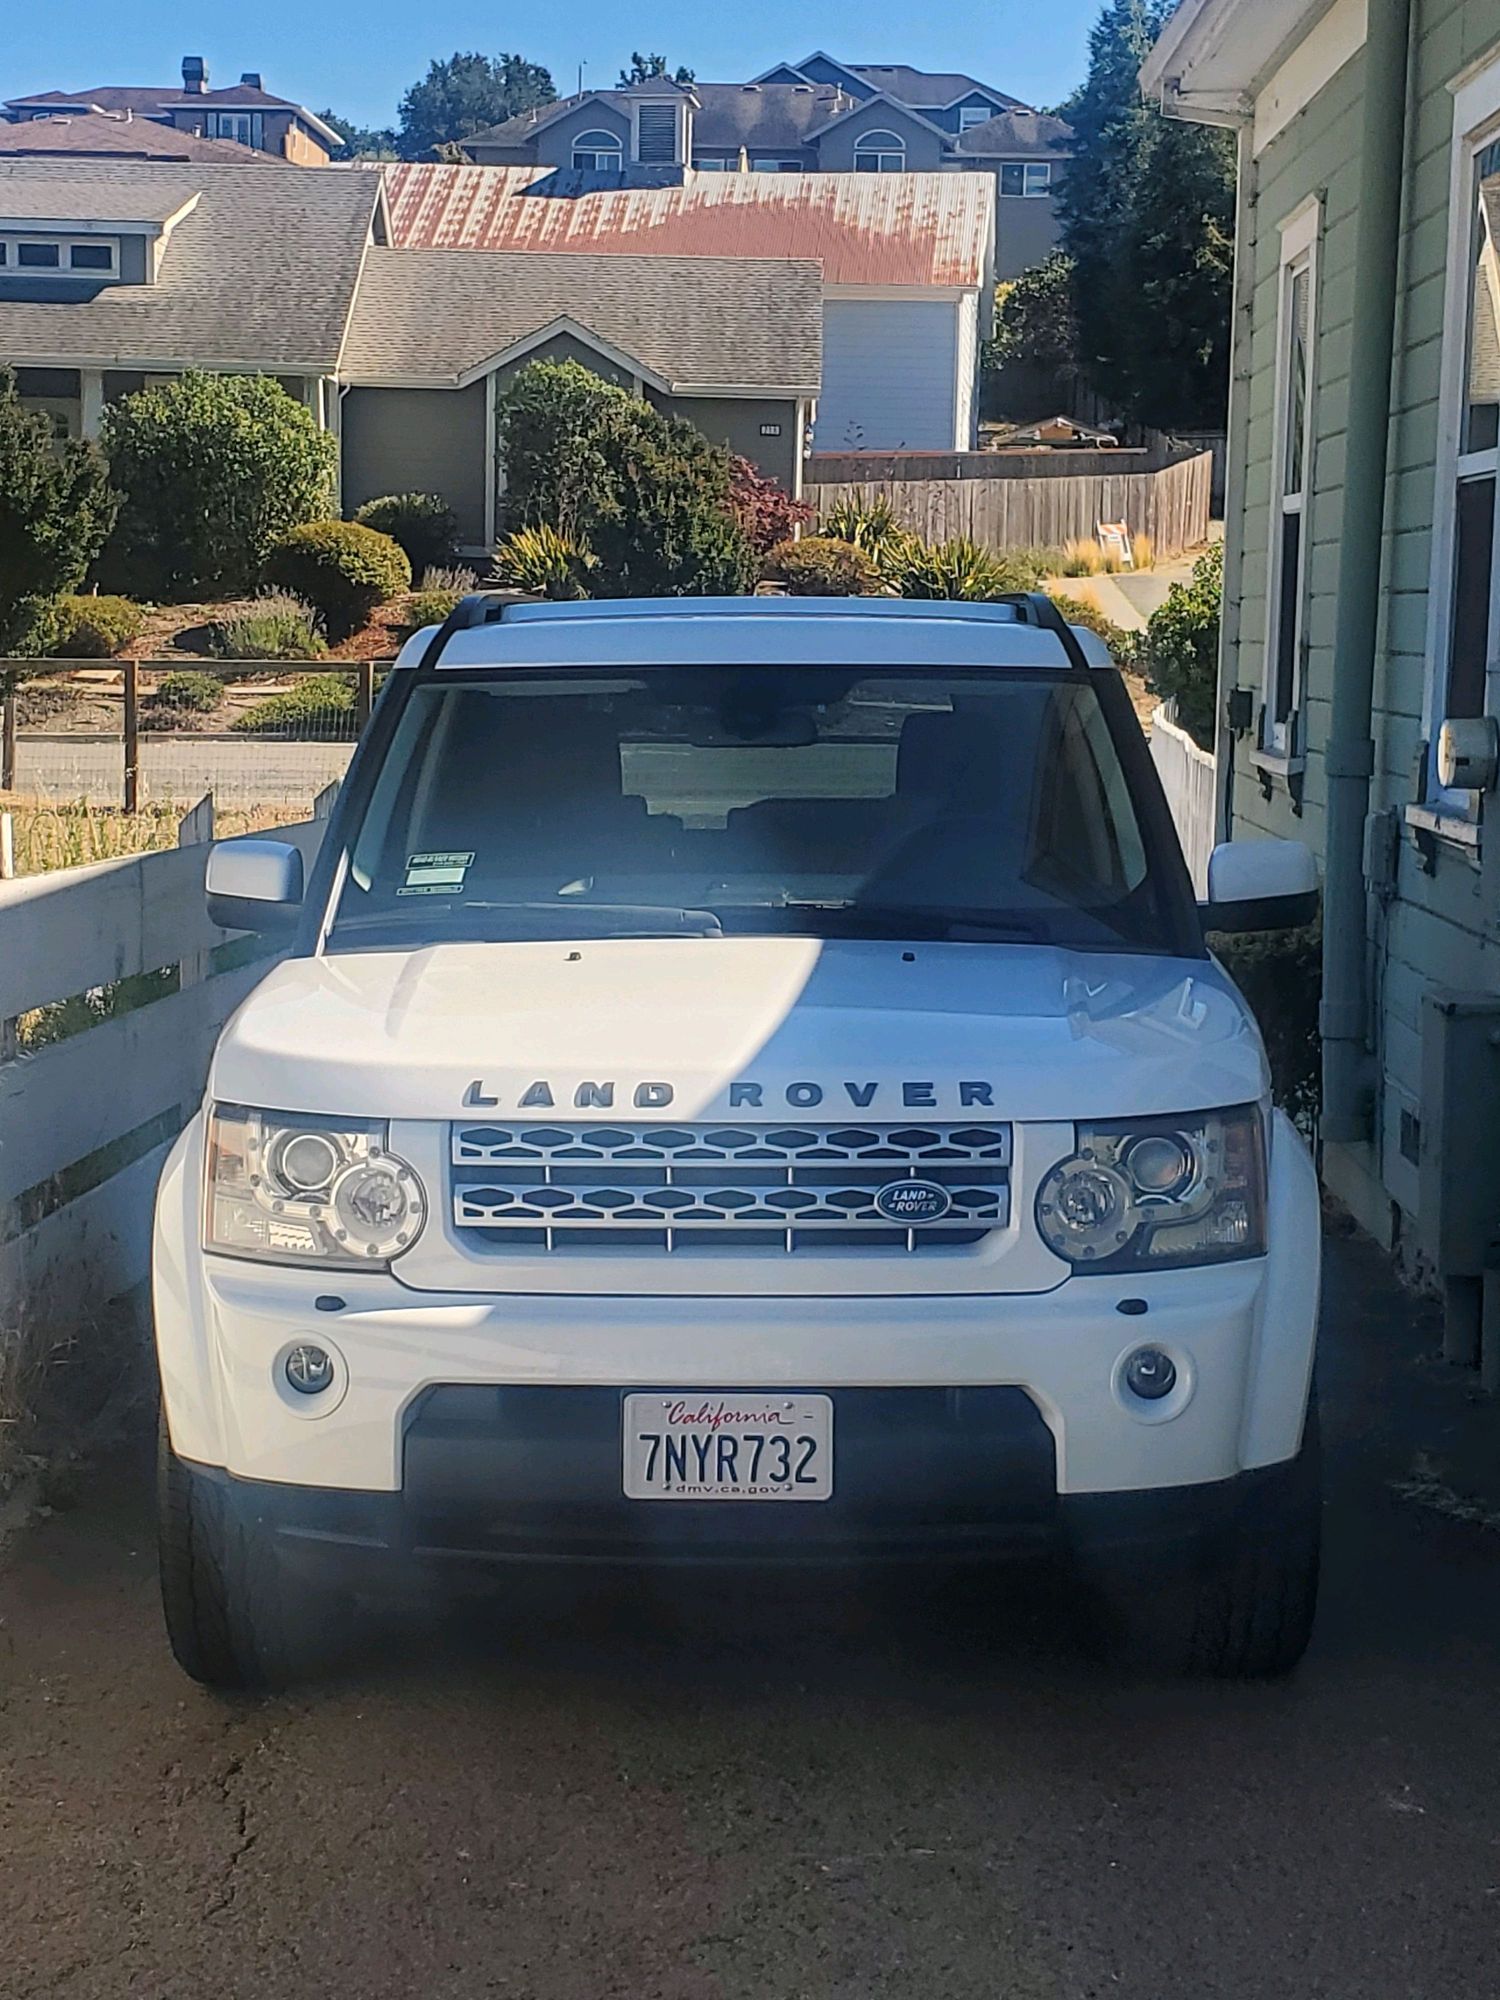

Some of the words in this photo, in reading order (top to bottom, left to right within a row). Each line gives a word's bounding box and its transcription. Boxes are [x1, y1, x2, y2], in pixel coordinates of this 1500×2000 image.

[462, 1080, 674, 1108] LAND
[729, 1081, 994, 1107] ROVER
[893, 1190, 927, 1200] LAND
[896, 1201, 937, 1211] ROVER
[668, 1401, 794, 1431] California
[639, 1434, 817, 1483] 7NYR732
[676, 1484, 781, 1494] dmv.ca.gov
